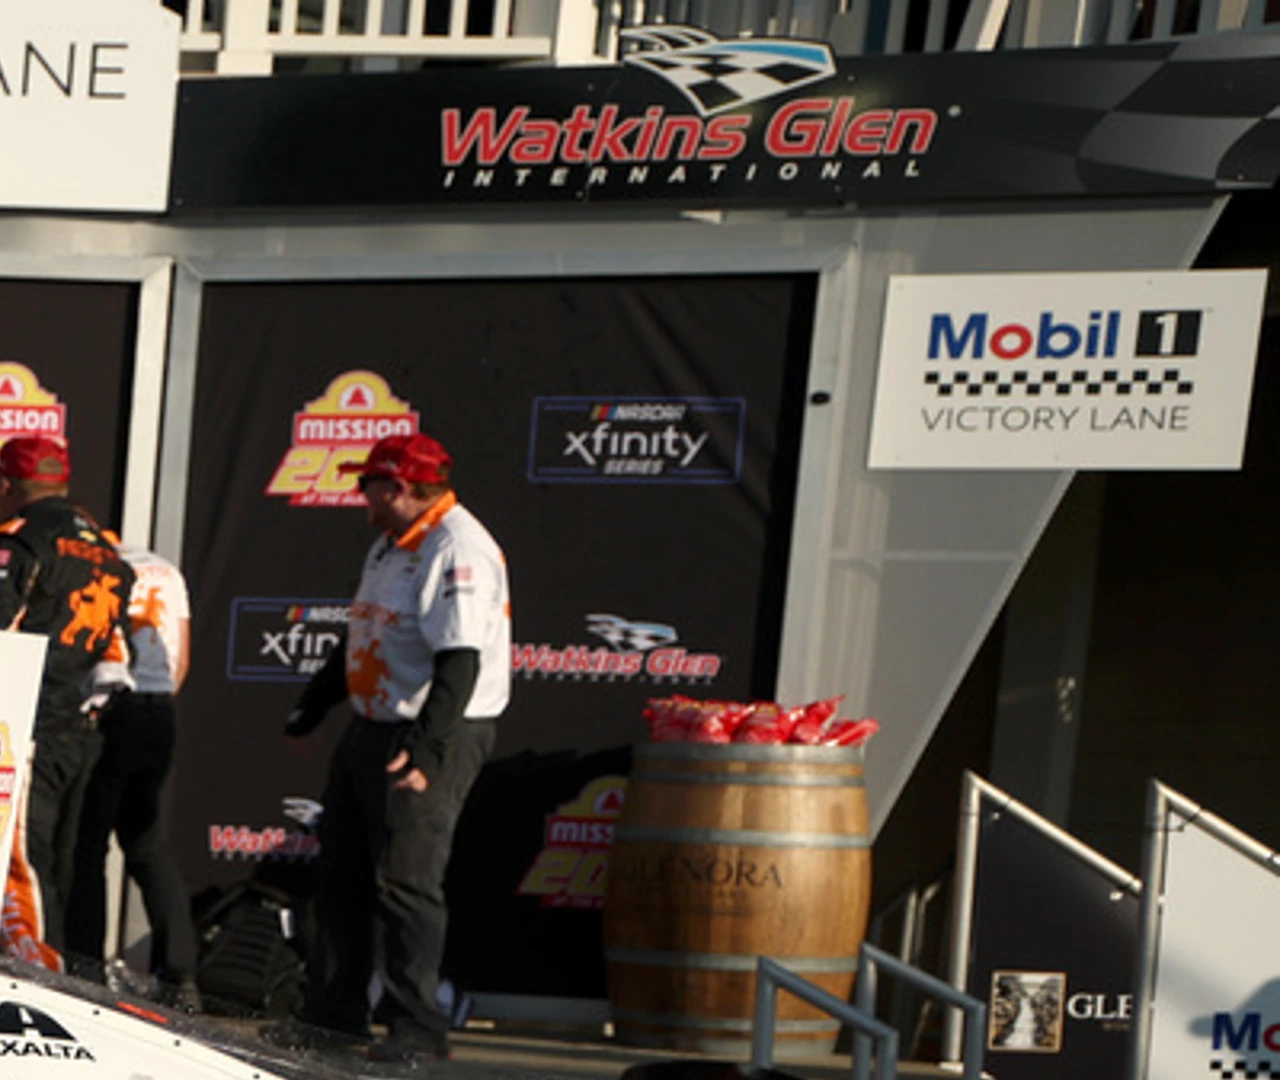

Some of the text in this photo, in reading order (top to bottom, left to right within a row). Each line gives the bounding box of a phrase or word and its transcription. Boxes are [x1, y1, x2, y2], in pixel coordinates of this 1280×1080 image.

[440, 96, 939, 166] Watkins Glen
[442, 159, 922, 188] INTERNATIONAL
[926, 310, 1188, 361] Mobil 1
[920, 405, 1191, 433] VICTORY LANE
[562, 419, 710, 466] xfinity
[259, 622, 340, 666] xfin
